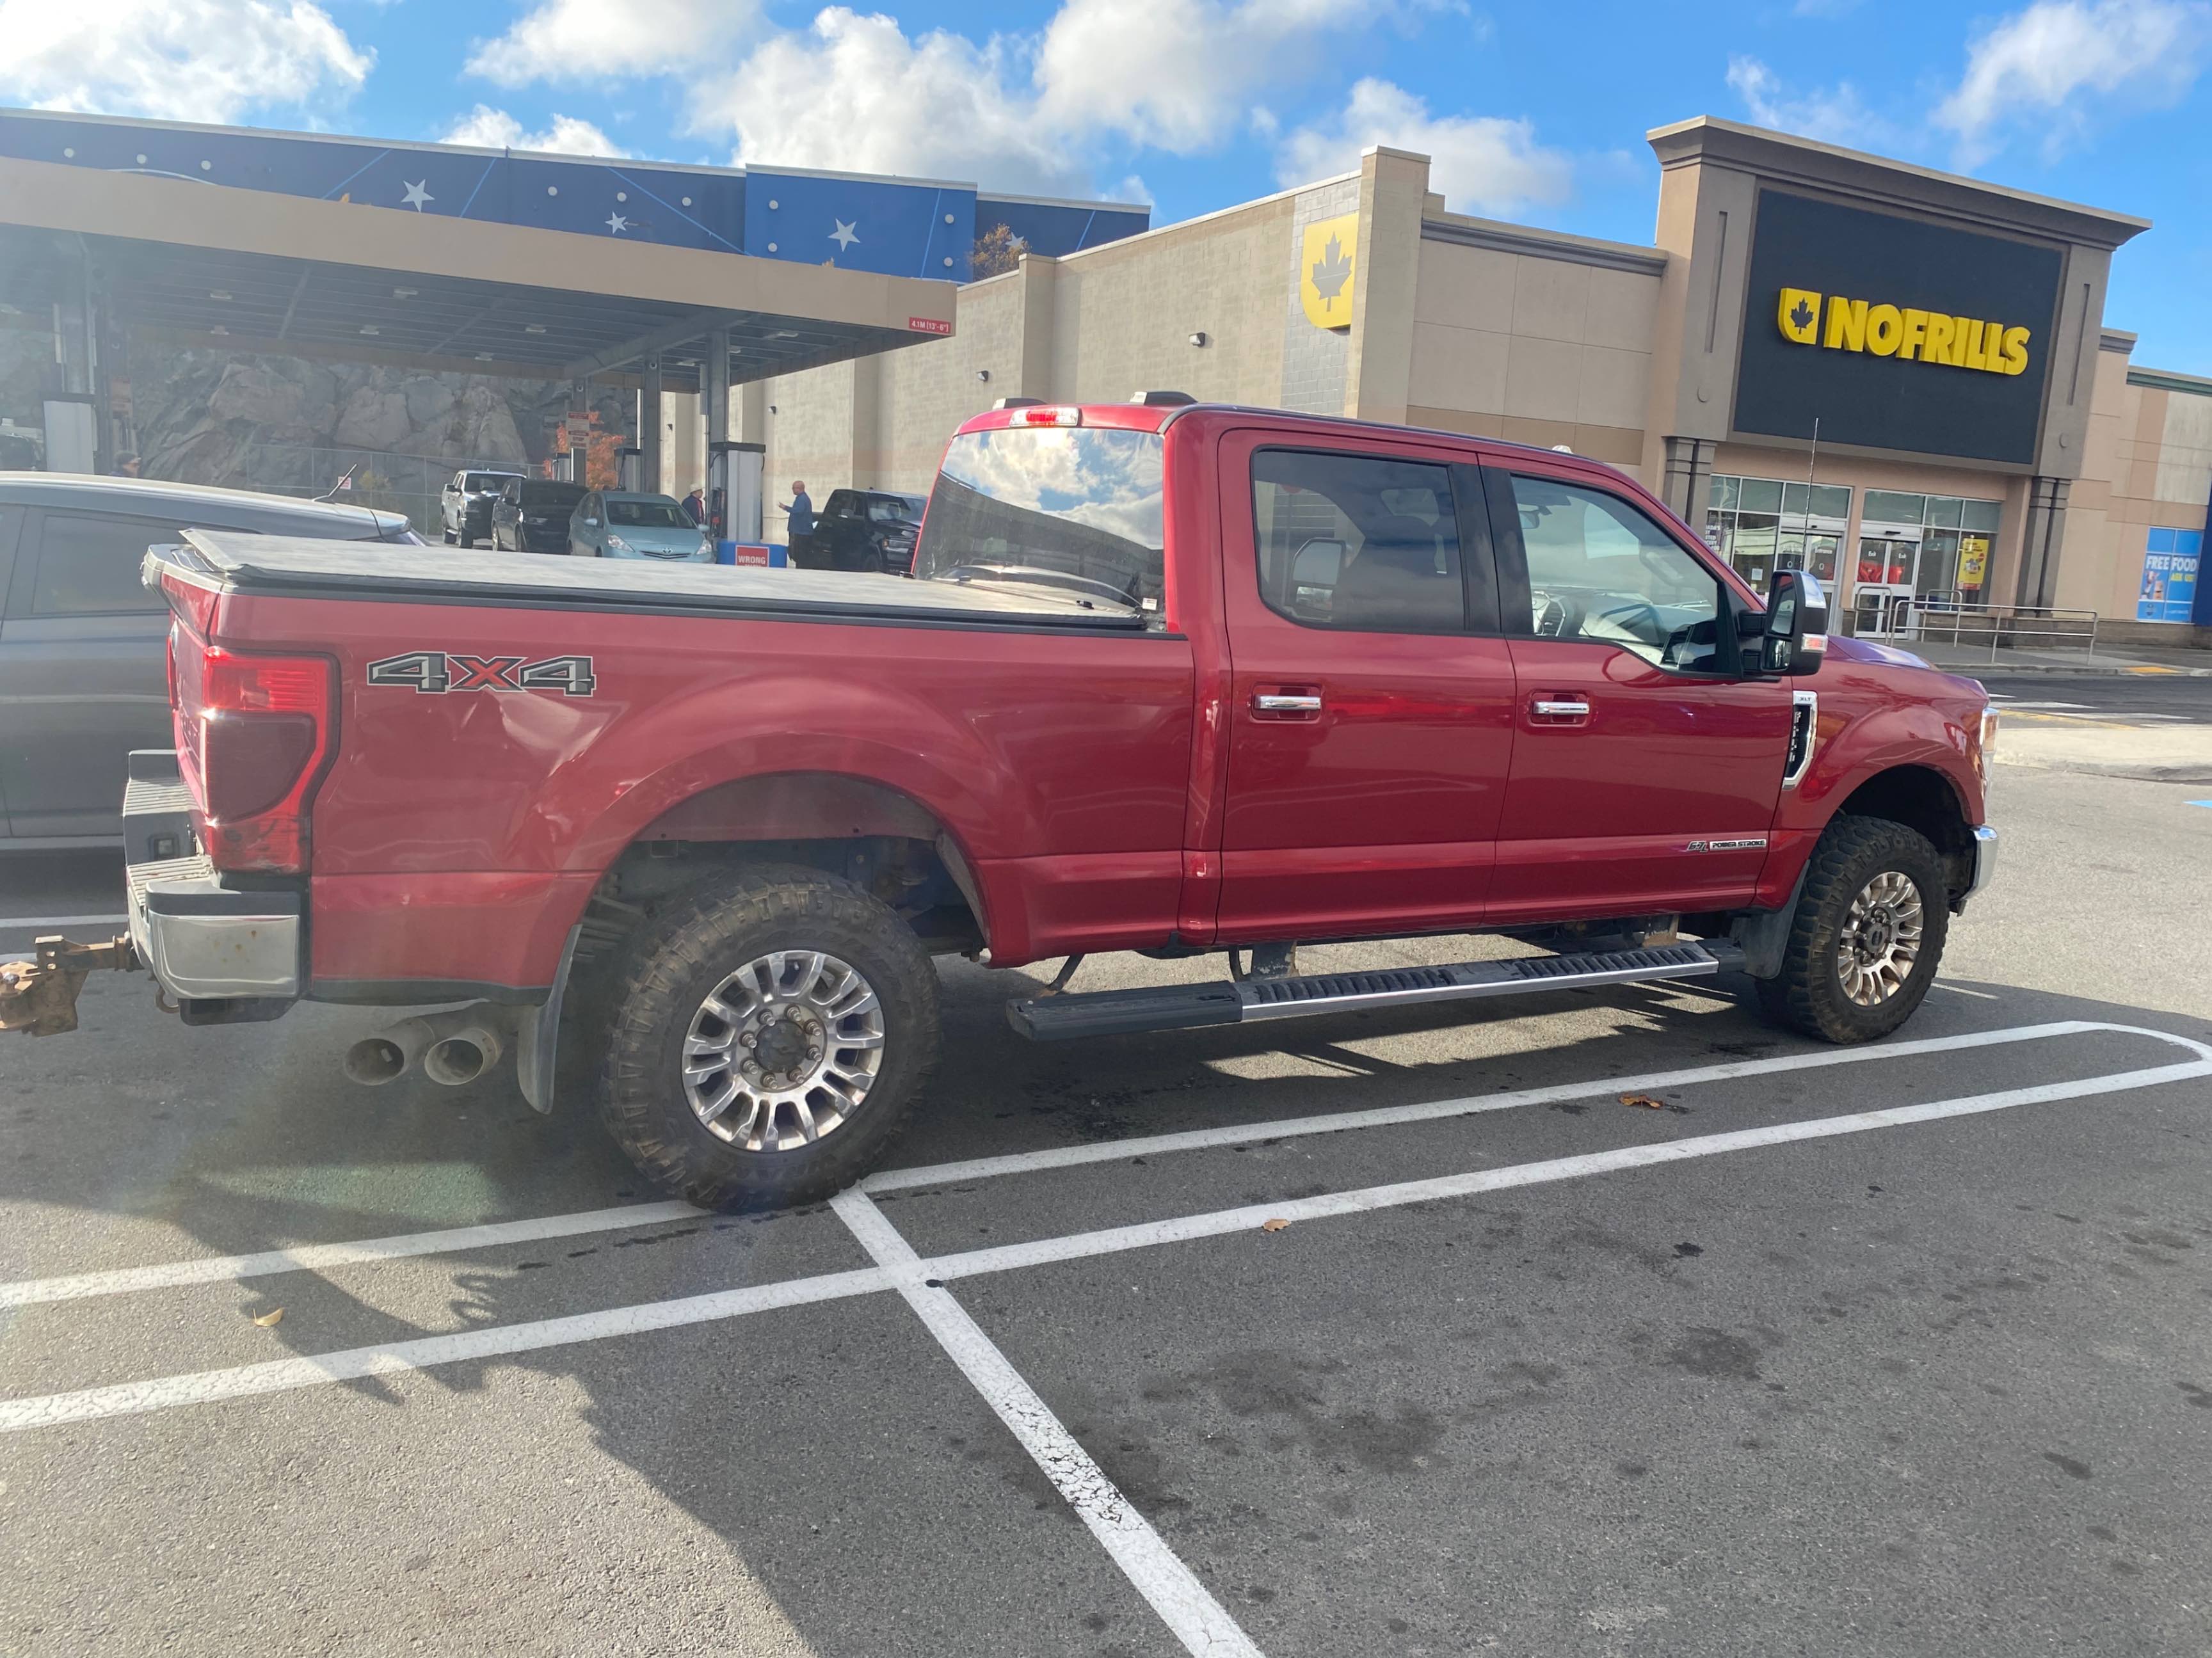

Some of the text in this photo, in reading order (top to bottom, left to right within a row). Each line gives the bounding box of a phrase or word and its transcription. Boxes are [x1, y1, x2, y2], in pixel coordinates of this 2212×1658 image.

[911, 320, 926, 328] 4.1M
[738, 555, 766, 564] WRONG
[2145, 555, 2197, 572] FREE FOOD
[367, 651, 596, 697] 4X4
